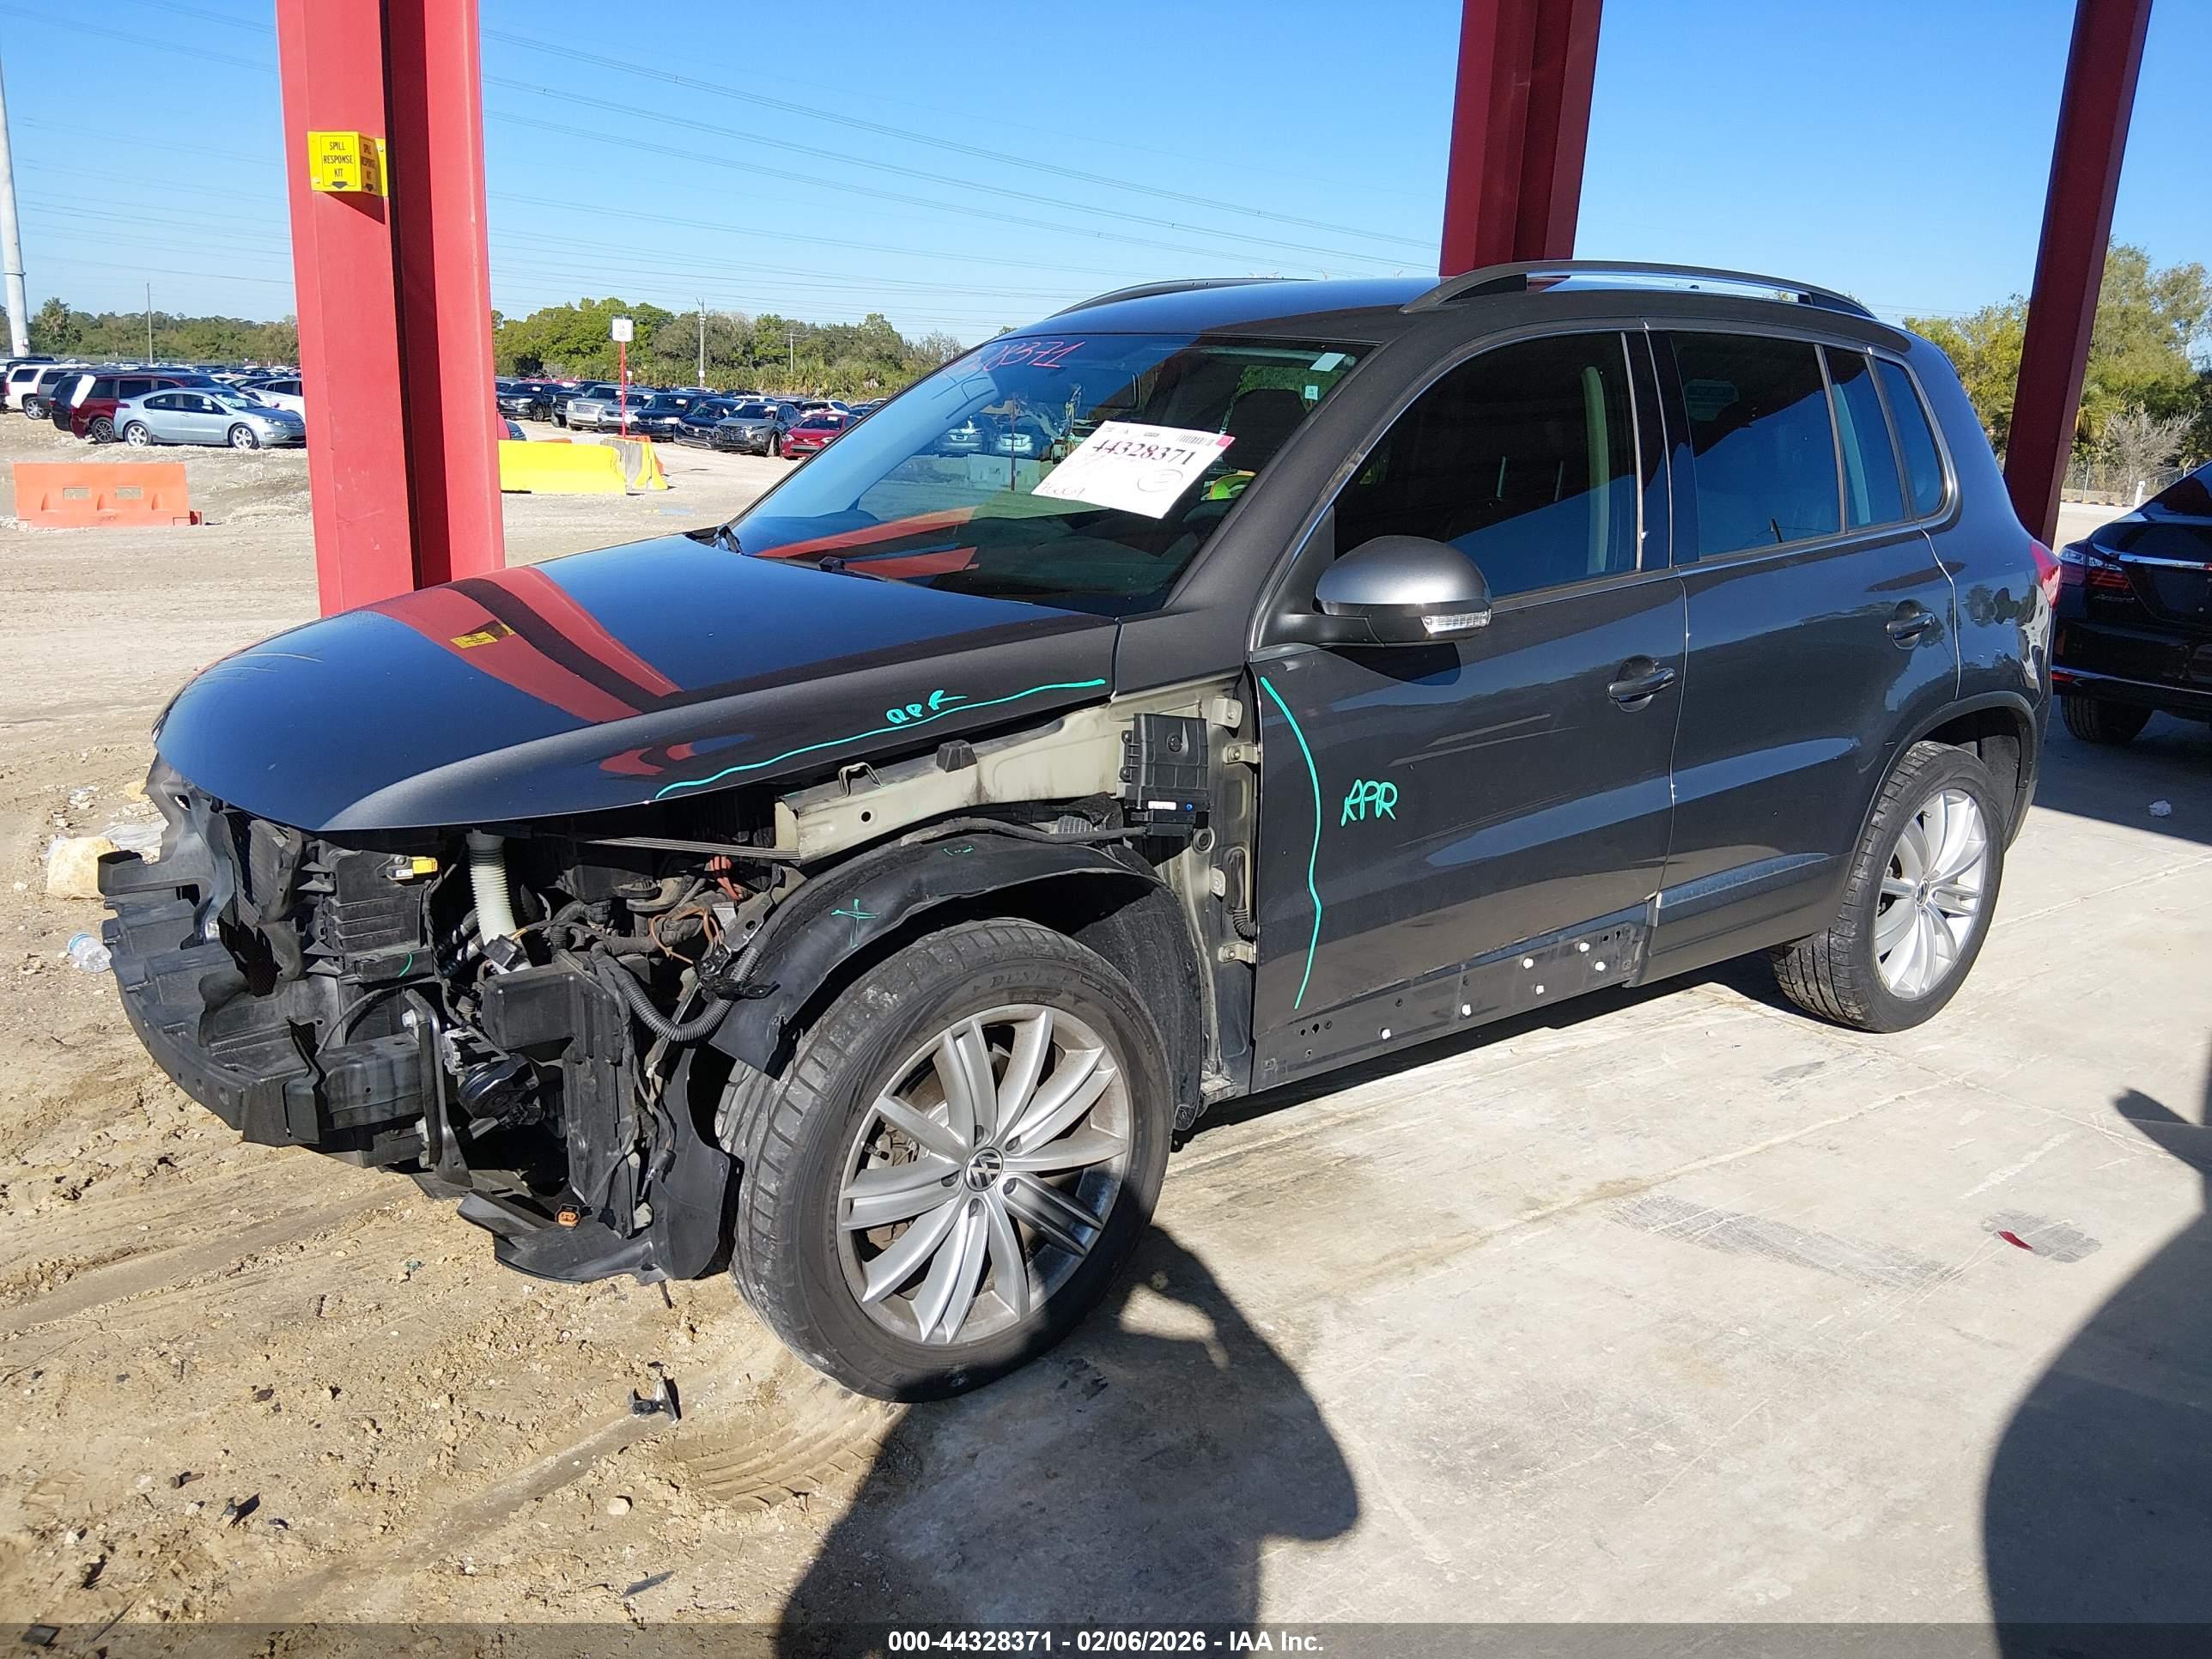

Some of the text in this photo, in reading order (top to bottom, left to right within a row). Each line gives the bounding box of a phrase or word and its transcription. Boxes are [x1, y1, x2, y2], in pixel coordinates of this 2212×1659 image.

[330, 142, 345, 150] SPILL
[323, 155, 353, 164] RESPONSE
[334, 168, 343, 177] KIT
[1092, 439, 1196, 465] 44328371
